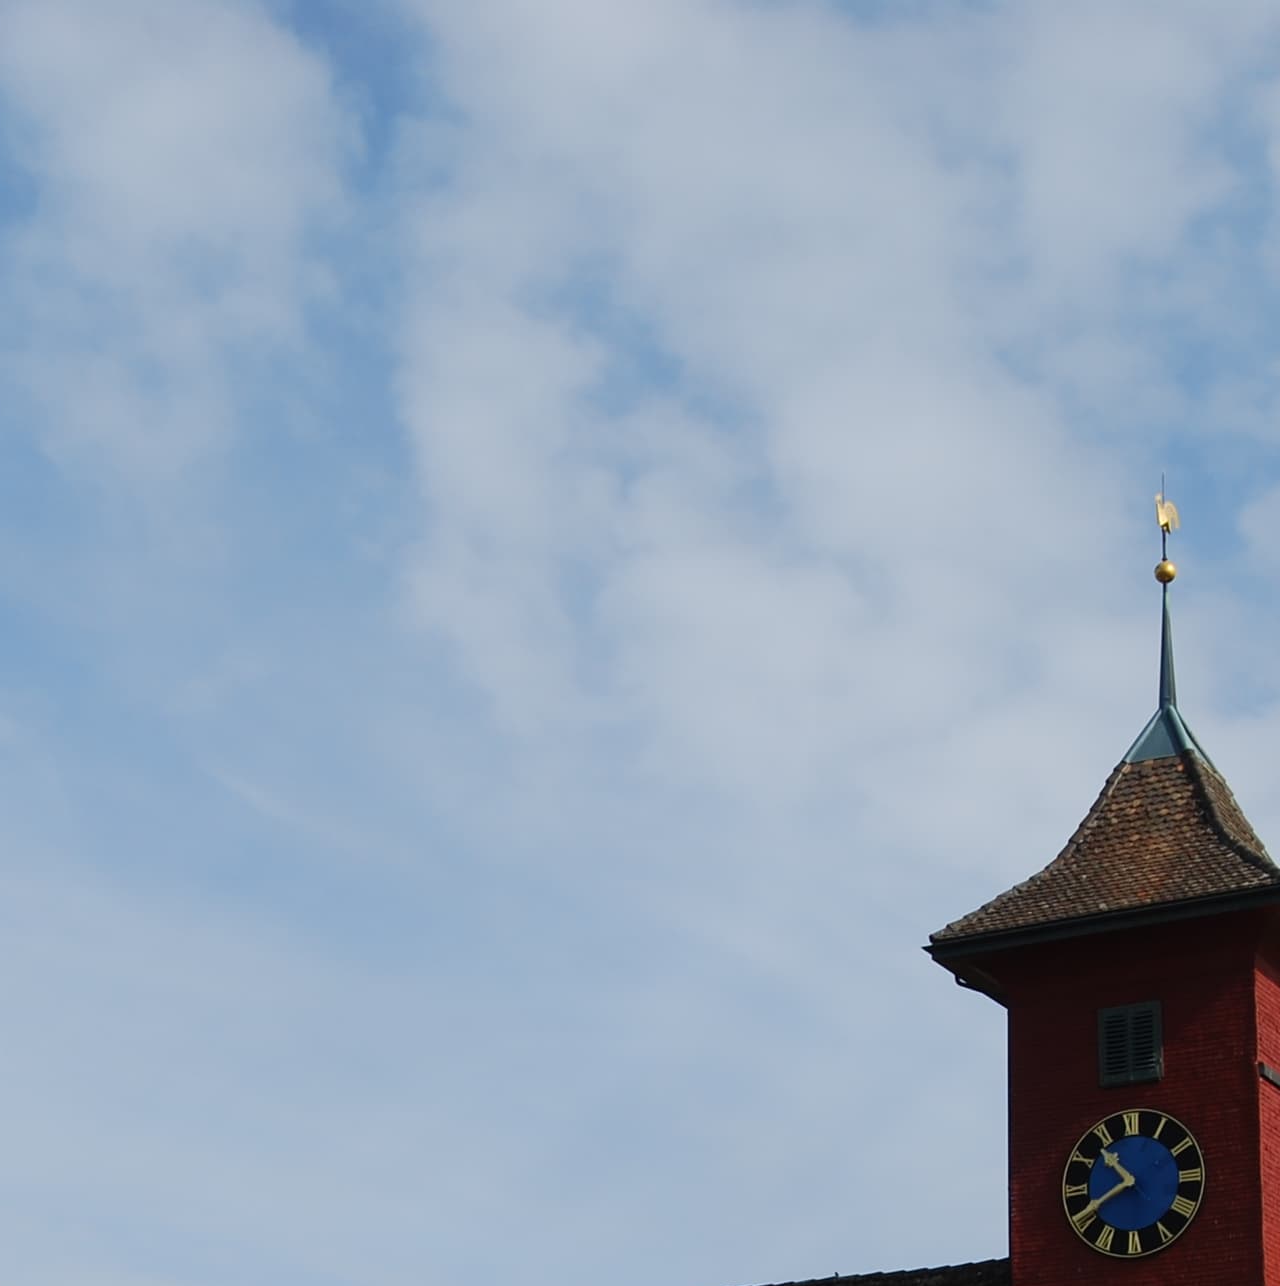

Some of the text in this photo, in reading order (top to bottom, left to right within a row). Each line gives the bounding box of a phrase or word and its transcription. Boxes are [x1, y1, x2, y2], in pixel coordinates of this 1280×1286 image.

[1092, 1122, 1114, 1148] XI
[1123, 1112, 1139, 1136] XII
[1153, 1117, 1168, 1139] I
[1171, 1136, 1193, 1157] II
[1072, 1151, 1095, 1168] X
[1179, 1168, 1201, 1183] III
[1065, 1183, 1088, 1197] IX
[1171, 1195, 1196, 1218] IIII
[1095, 1225, 1115, 1251] VII
[1128, 1231, 1142, 1253] VI
[1157, 1221, 1173, 1243] V
